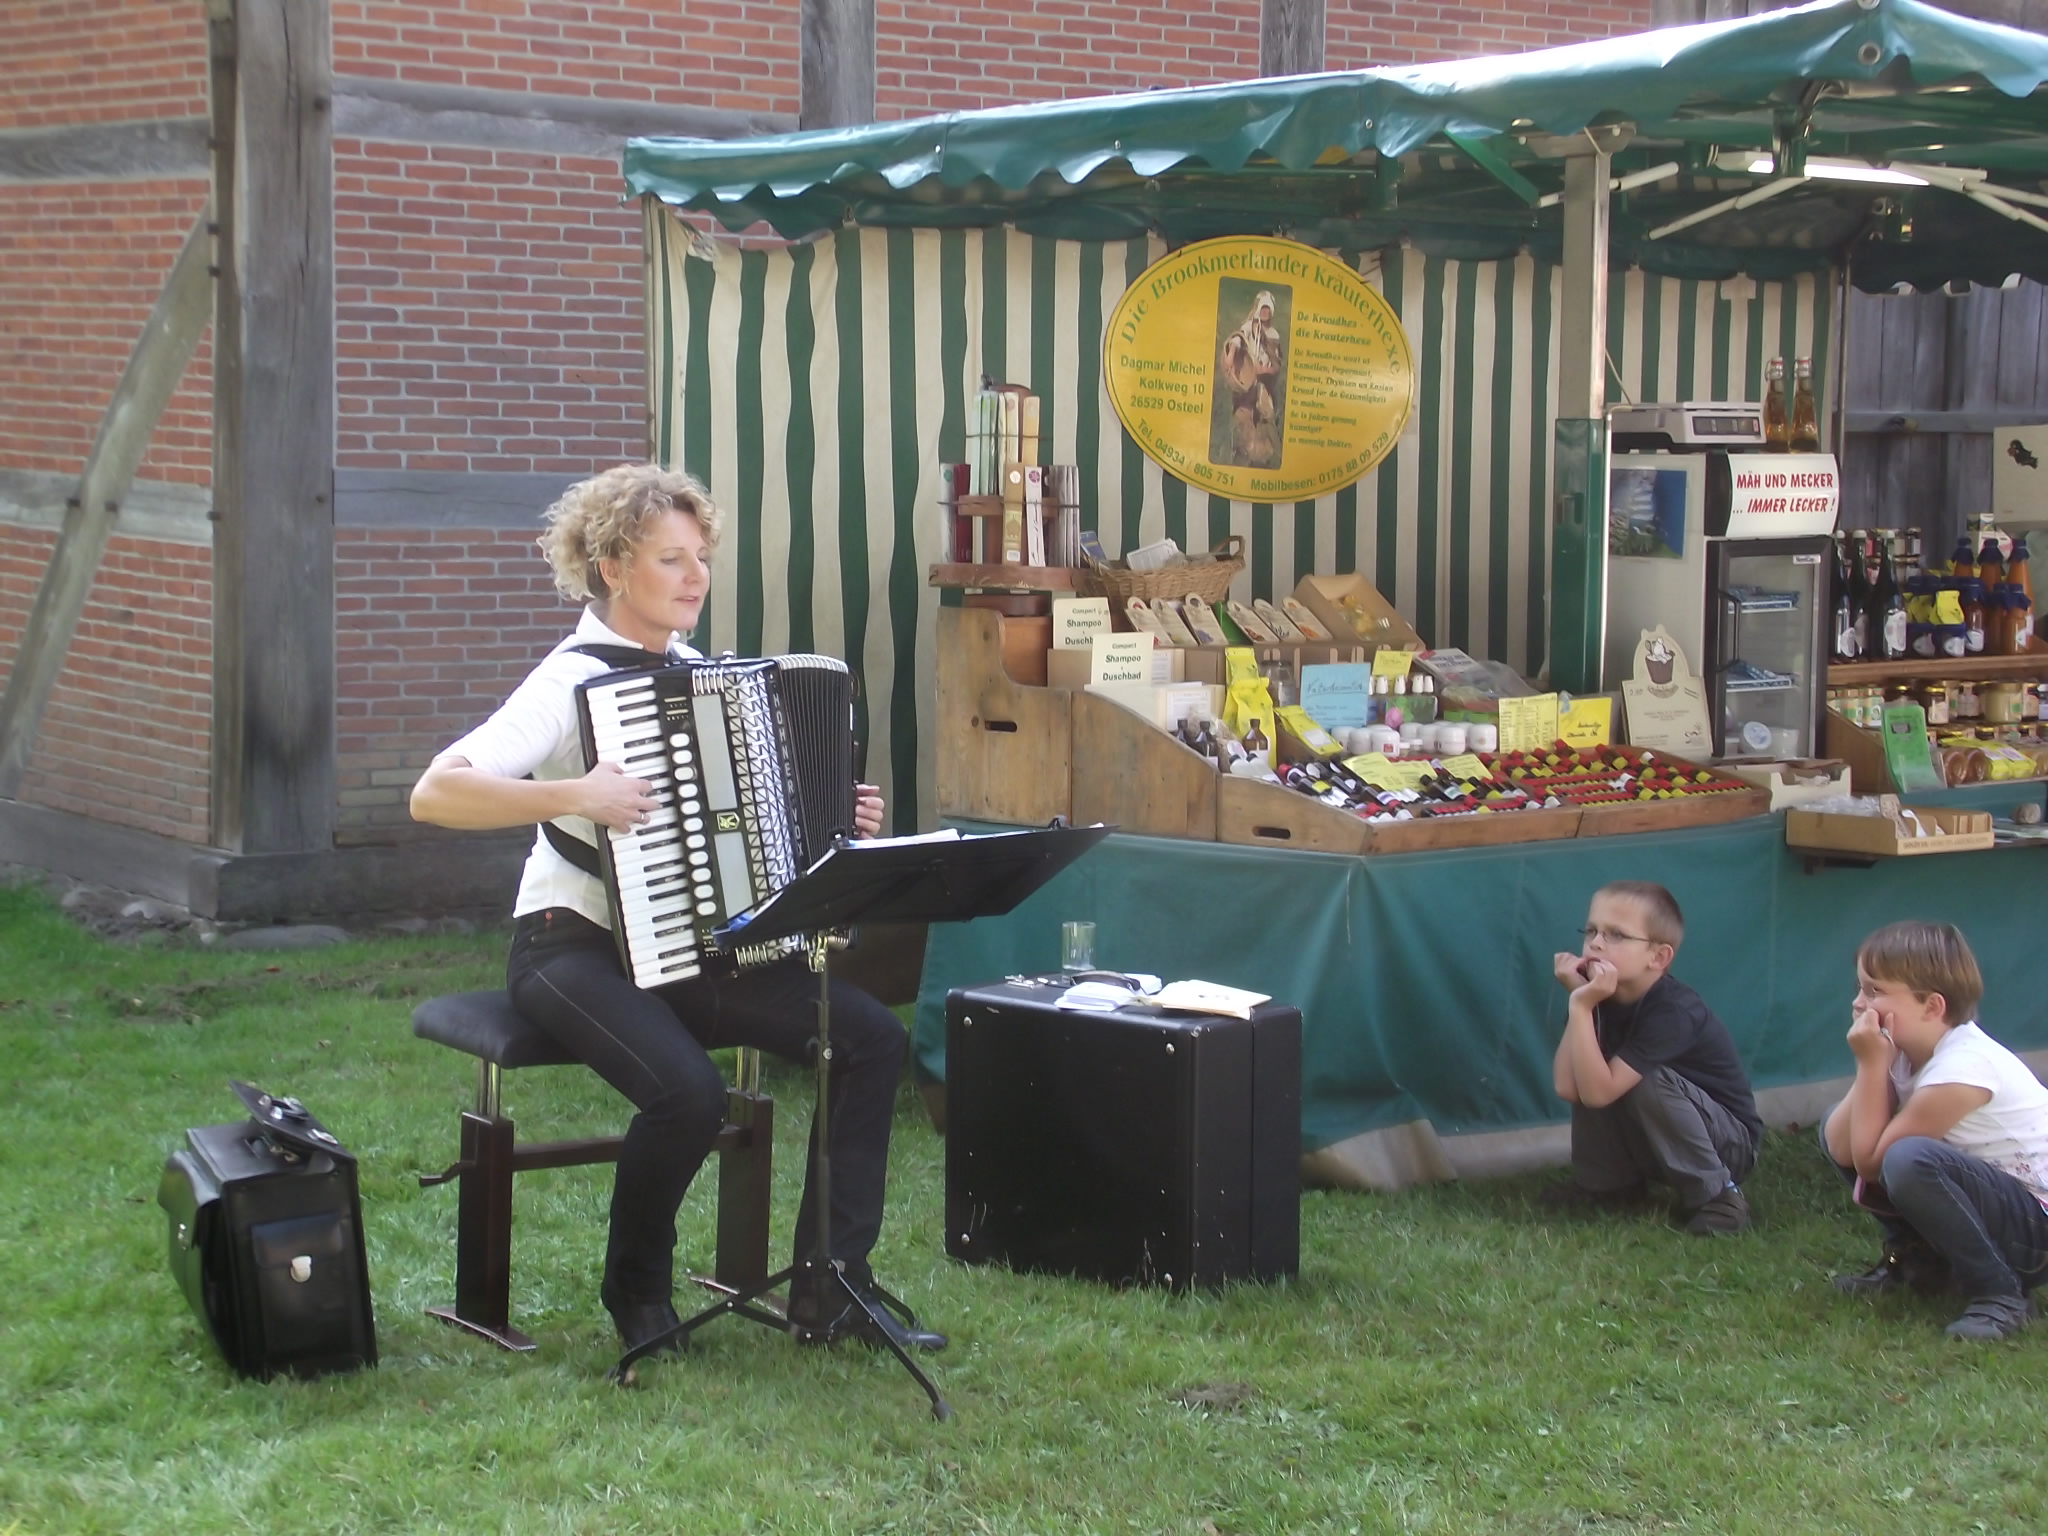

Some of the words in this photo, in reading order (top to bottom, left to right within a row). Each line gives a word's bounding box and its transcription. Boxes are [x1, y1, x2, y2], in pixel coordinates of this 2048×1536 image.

[1121, 299, 1149, 344] Die
[1314, 265, 1400, 375] Kräuterhexe
[1296, 328, 1310, 338] die
[1120, 355, 1165, 372] Dagmar
[1169, 360, 1206, 375] Michel
[1140, 378, 1188, 396] Kolkweg
[1193, 384, 1205, 394] 10
[1130, 395, 1164, 409] 26529
[1167, 399, 1204, 413] Osteel
[1138, 418, 1153, 442] Tel.
[1155, 438, 1185, 466] 04934
[1194, 463, 1213, 480] 805
[1217, 471, 1235, 486] 751
[1319, 466, 1344, 484] 0175
[1345, 460, 1358, 473] 88
[1360, 449, 1372, 463] 09
[1372, 431, 1389, 450] 529
[1765, 474, 1787, 488] UND
[1790, 473, 1833, 488] MECKER
[1747, 498, 1787, 513] IMMER
[1789, 498, 1828, 513] LECKER
[1066, 619, 1102, 628] Shampoo
[1105, 654, 1141, 664] Shampoo
[1103, 671, 1142, 681] Duschbad
[773, 692, 794, 794] HOHNER
